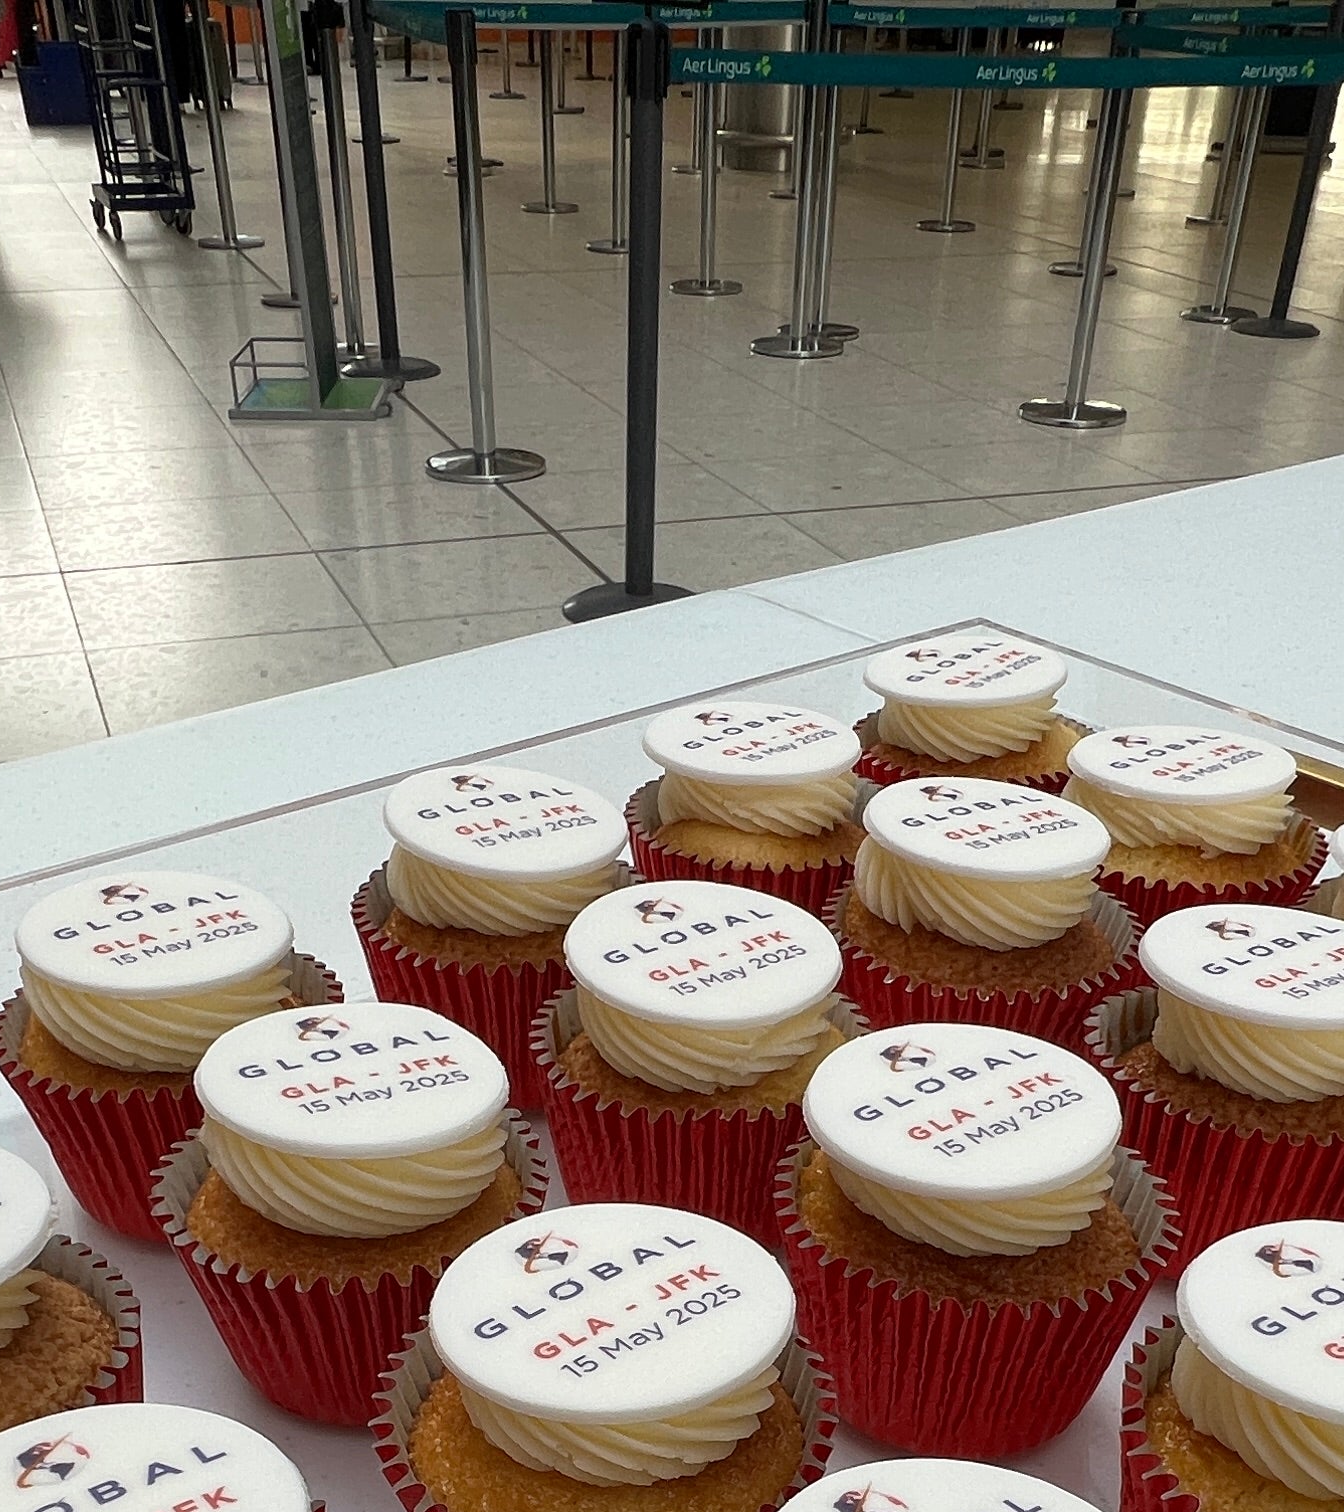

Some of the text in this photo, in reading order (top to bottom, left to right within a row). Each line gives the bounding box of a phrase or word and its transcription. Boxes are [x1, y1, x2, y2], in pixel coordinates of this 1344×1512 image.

[487, 8, 515, 21] Lingus
[682, 57, 751, 80] Aer Lingus
[976, 65, 1038, 85] Aer Lingus
[1241, 65, 1298, 82] Aer Lingus
[906, 643, 1003, 682] GLOBAL
[683, 712, 802, 749] GLOBAL
[722, 723, 822, 756] GLA JFK
[741, 730, 838, 762] 15 May 2025
[1109, 735, 1221, 769] GLOBAL
[1152, 744, 1245, 776] GLA JFK
[417, 788, 573, 819] GLOBAL
[455, 805, 585, 835] GLA JFK
[901, 796, 1043, 827] GLOBAL
[472, 816, 598, 848] 15 May 2025
[944, 810, 1062, 840] GLA JFK
[965, 819, 1078, 850] 15 May 2025
[53, 892, 238, 940] GLOBAL
[93, 910, 247, 954] GLA JFK
[110, 922, 258, 966] 15 May 2025
[603, 910, 773, 963] GLOBAL
[1202, 926, 1341, 975] GLOBAL
[649, 931, 791, 981] GLA JFK
[669, 945, 807, 996] 15 May 2025
[1255, 968, 1308, 988] GLA
[1282, 987, 1310, 999] 15
[238, 1031, 450, 1078] GLOBAL
[281, 1055, 458, 1099] GLA JFK
[298, 1070, 469, 1114] 15 May 2025
[854, 1049, 1038, 1121] GLOBAL
[907, 1073, 1063, 1140] GLA JFK
[933, 1089, 1083, 1157] 15 May 2025
[474, 1236, 696, 1339] GLOBAL
[533, 1318, 615, 1359] GLA
[655, 1264, 720, 1300] JFK
[561, 1284, 741, 1378] 15 May 2025
